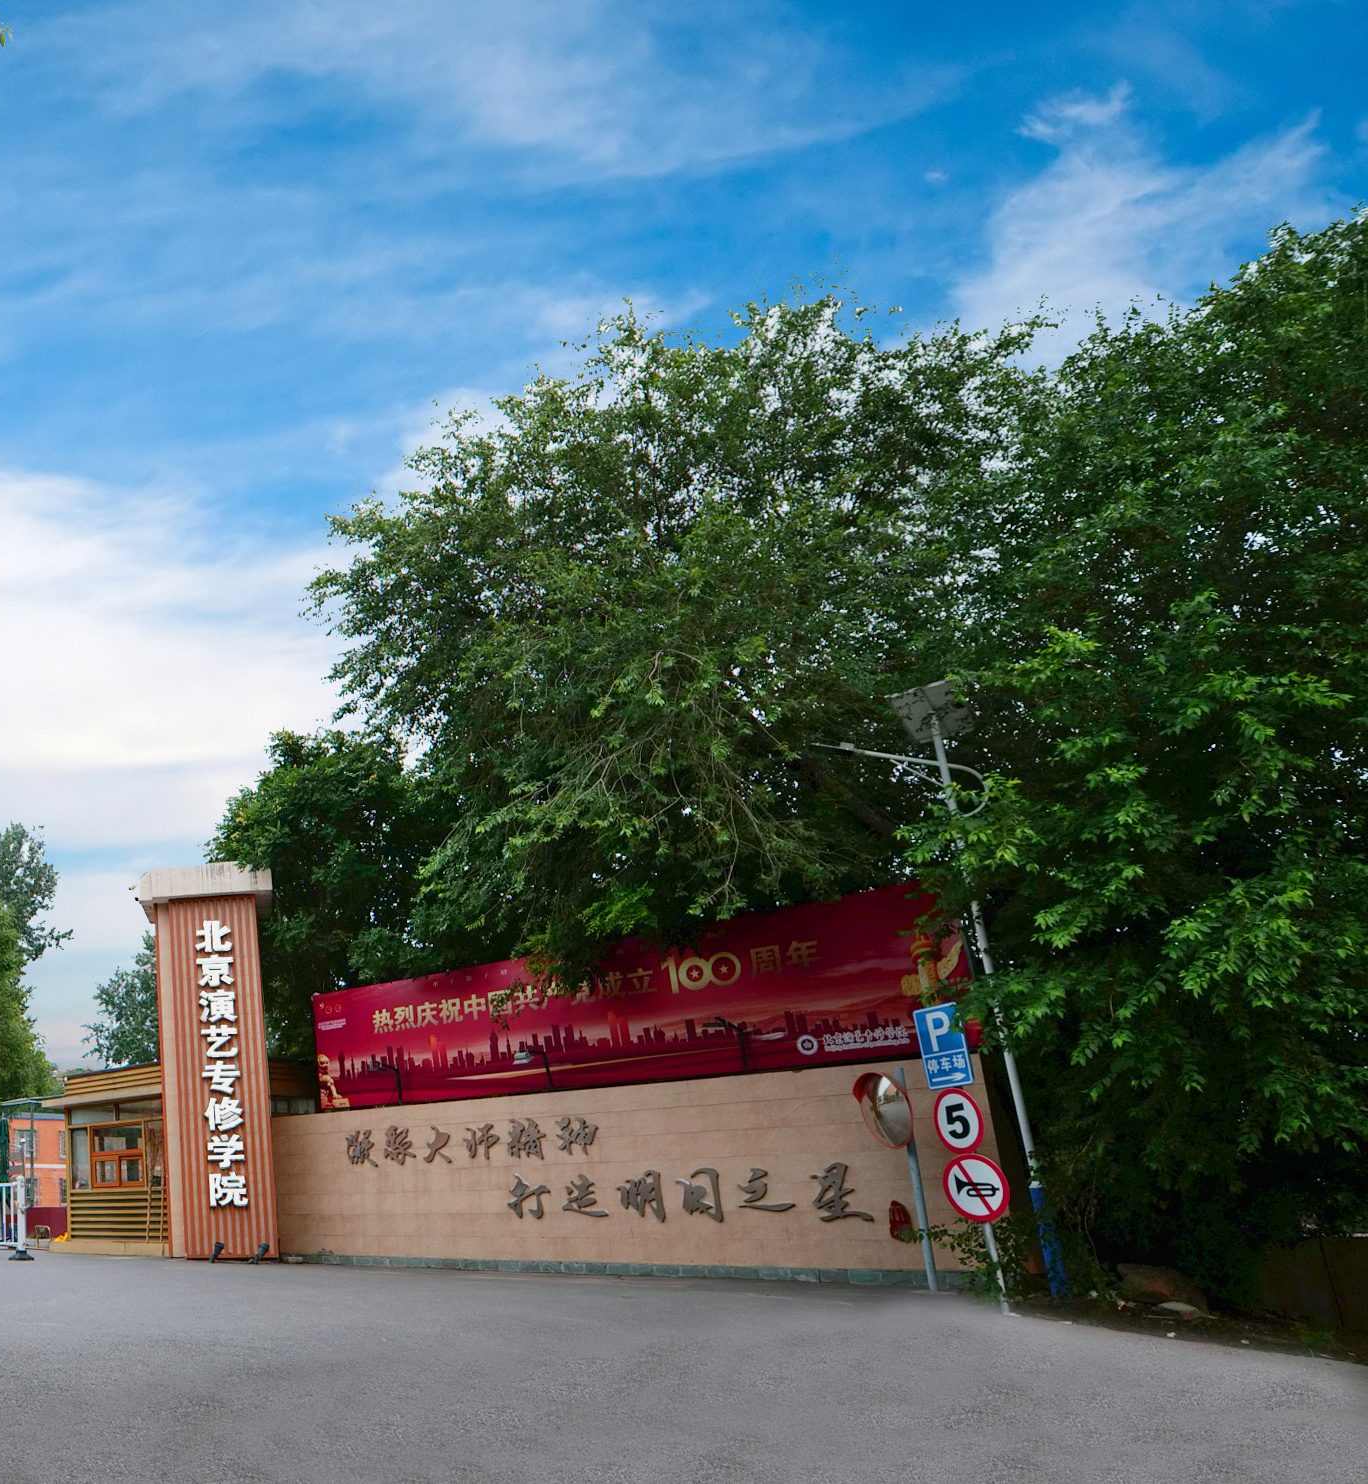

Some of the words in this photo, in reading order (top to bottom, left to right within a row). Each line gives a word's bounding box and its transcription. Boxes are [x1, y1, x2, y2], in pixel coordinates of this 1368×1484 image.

[925, 1010, 951, 1052] P
[195, 919, 249, 1207] 北京演艺专修学院
[927, 1053, 966, 1075] 停车场
[945, 1102, 971, 1140] 5
